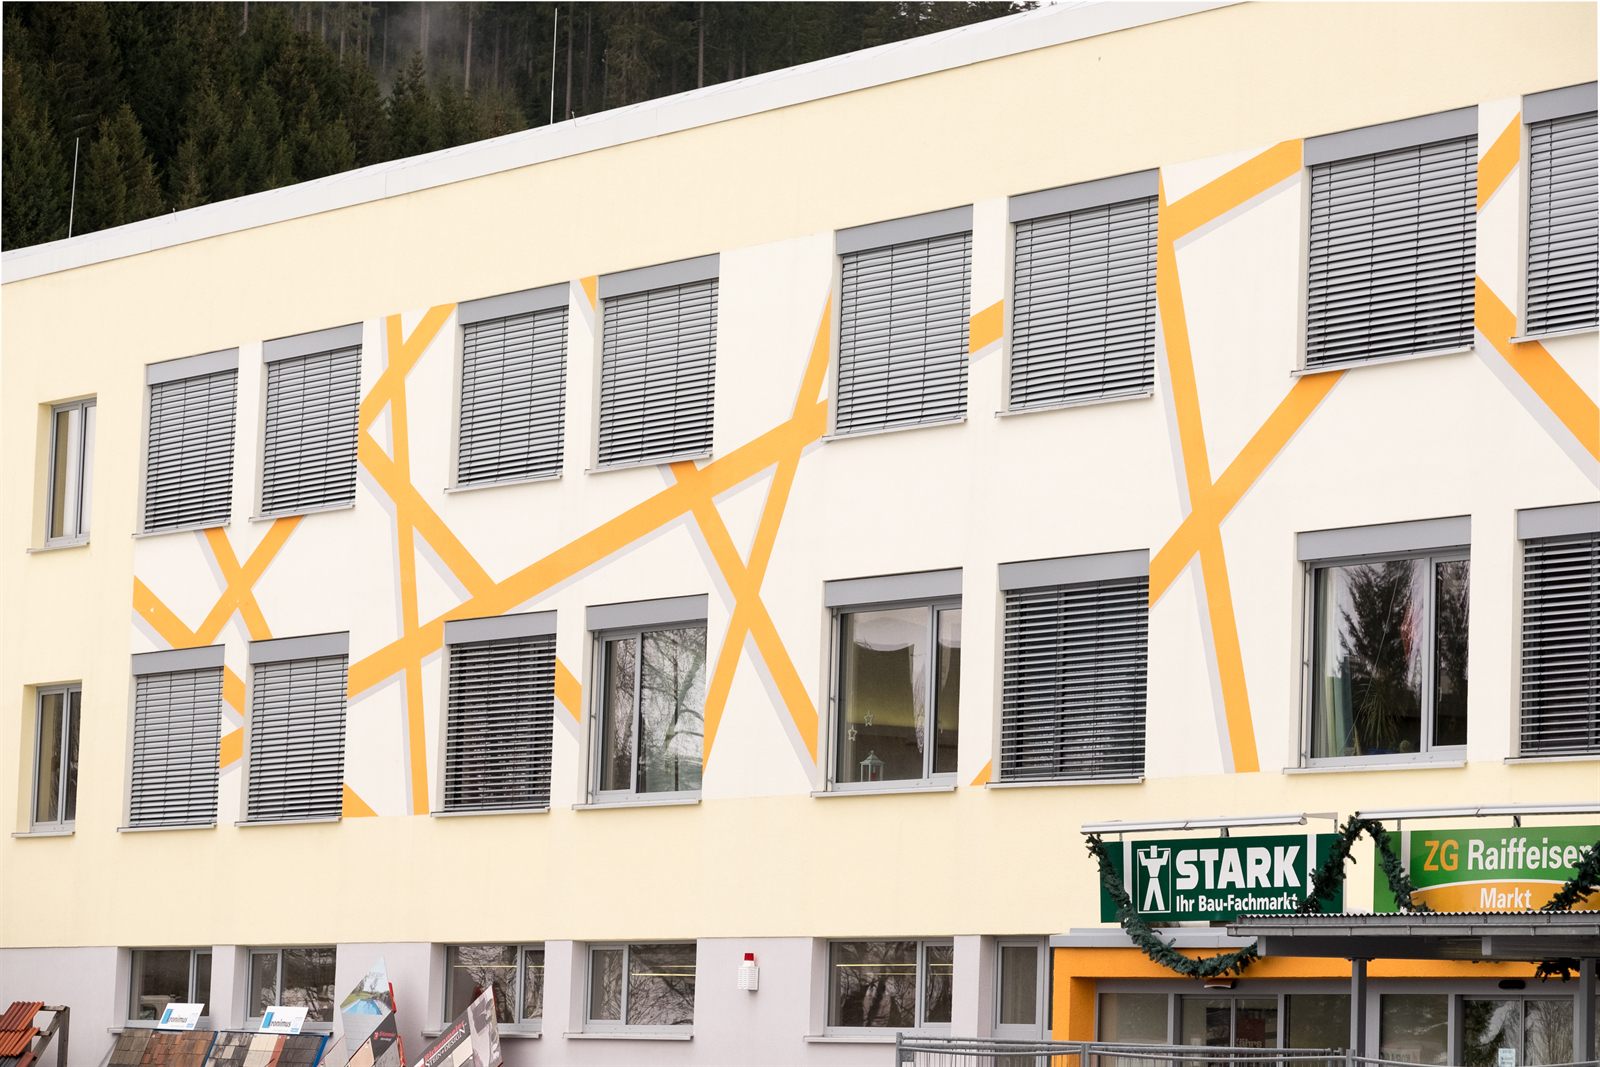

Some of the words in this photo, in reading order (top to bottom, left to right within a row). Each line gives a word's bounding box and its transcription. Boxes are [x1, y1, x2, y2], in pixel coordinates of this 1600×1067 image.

[1176, 846, 1301, 890] STARK
[1424, 839, 1459, 871] ZG
[1176, 895, 1195, 912] Ihr
[1198, 892, 1298, 912] Bau-Fachmarkt
[1480, 888, 1532, 909] Markt
